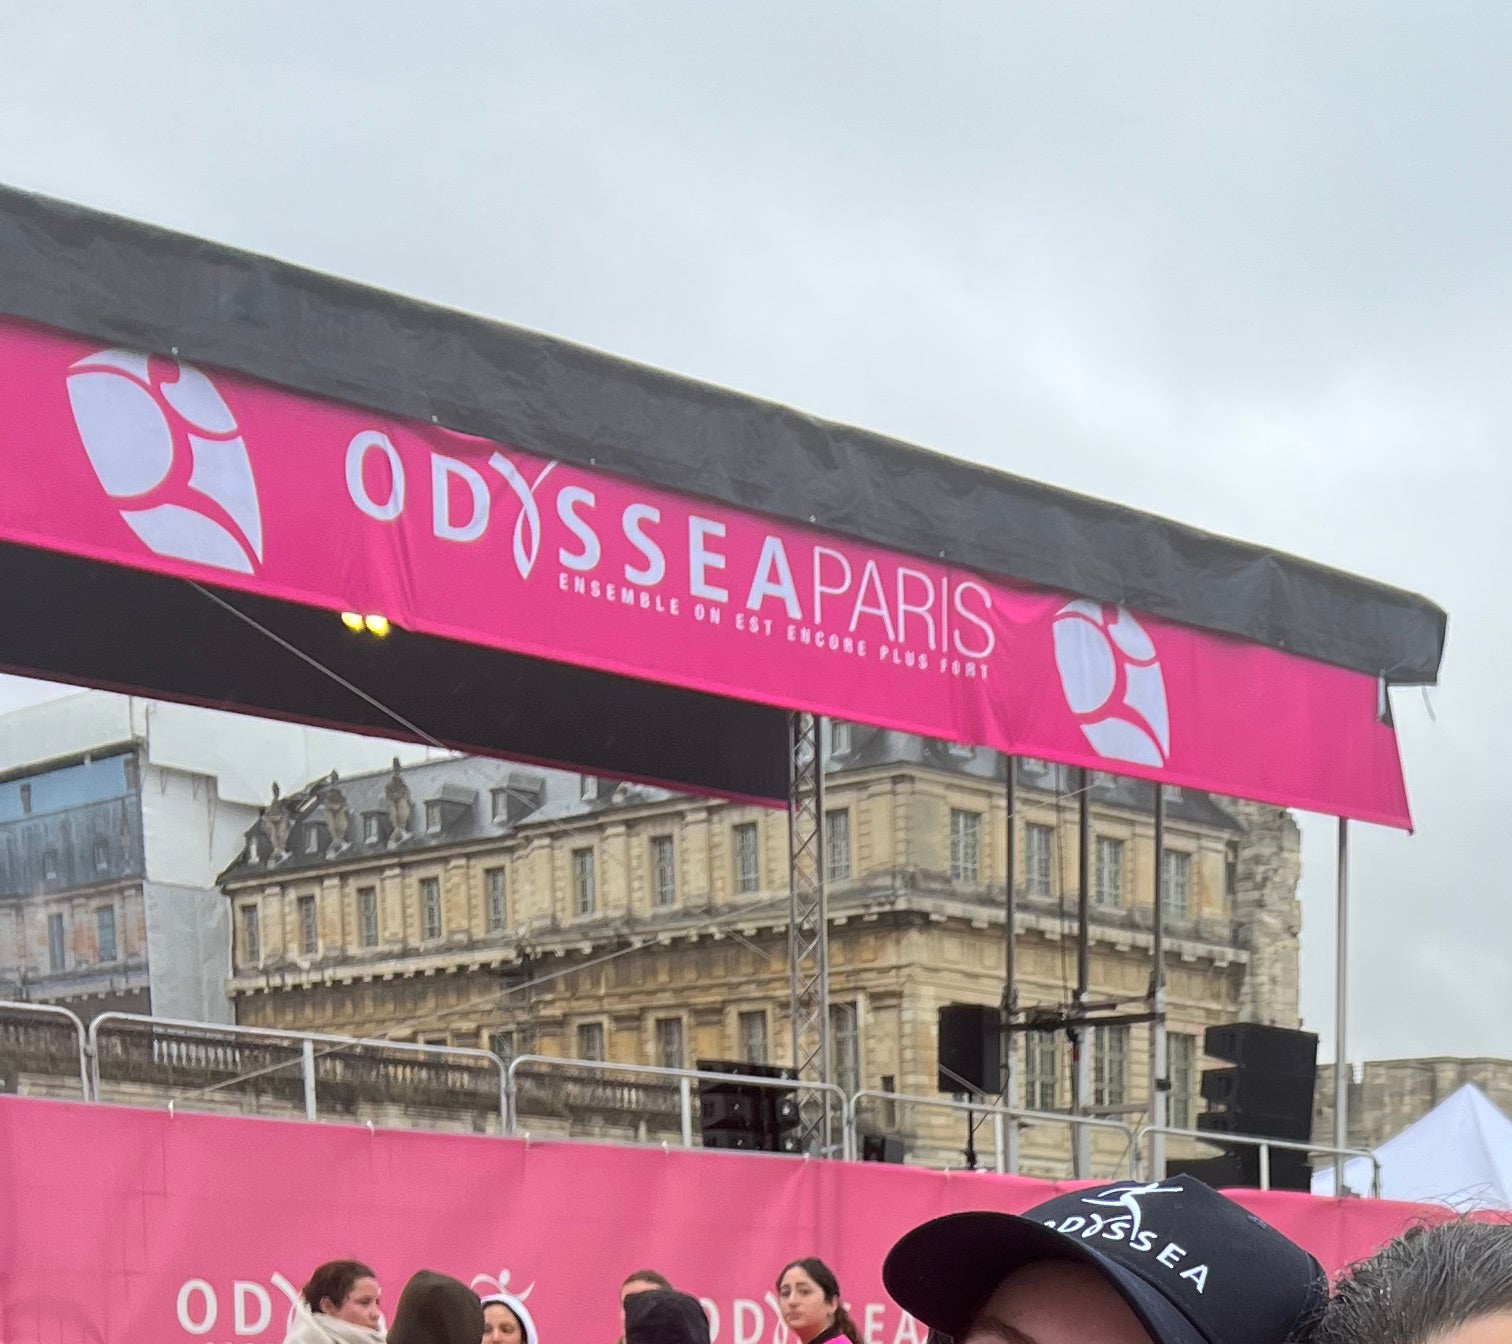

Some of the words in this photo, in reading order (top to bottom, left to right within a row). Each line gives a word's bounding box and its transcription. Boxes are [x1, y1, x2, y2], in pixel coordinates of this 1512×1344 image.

[559, 572, 680, 617] ENSEMBLE
[694, 603, 721, 625] ON
[735, 612, 775, 637] EST
[787, 623, 867, 657] ENCORE
[879, 644, 928, 671] PLUS
[940, 656, 990, 680] FORT
